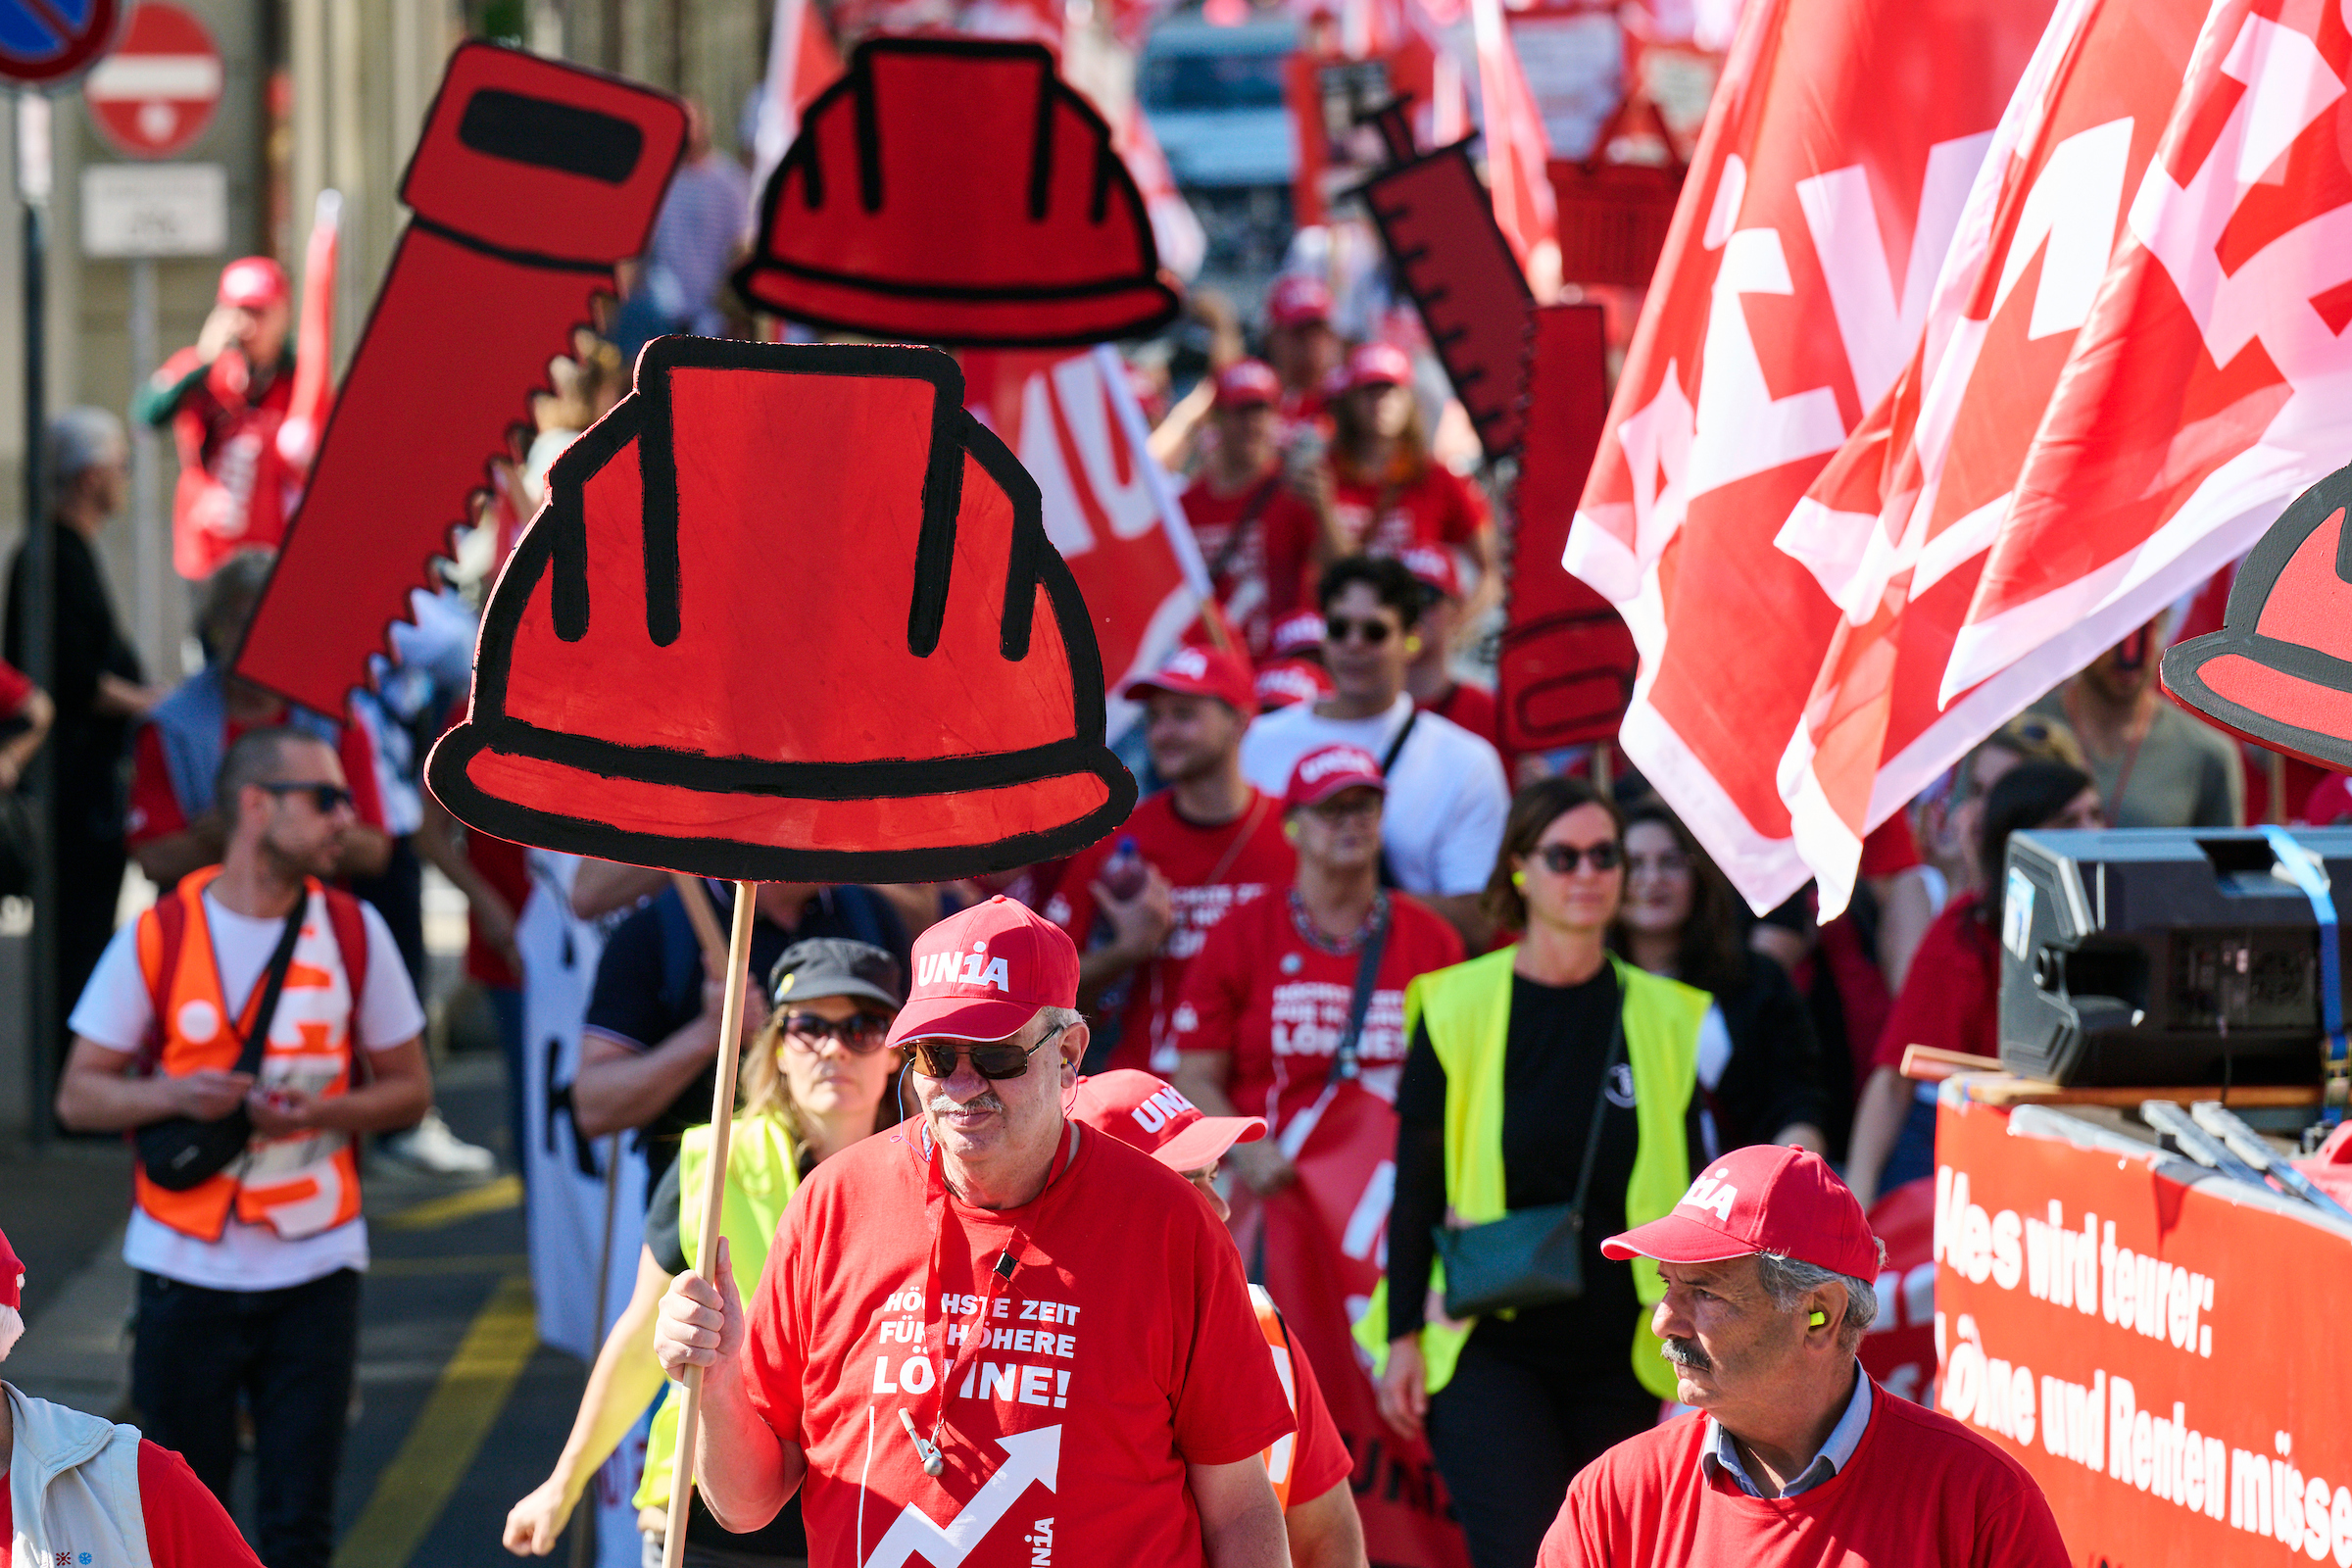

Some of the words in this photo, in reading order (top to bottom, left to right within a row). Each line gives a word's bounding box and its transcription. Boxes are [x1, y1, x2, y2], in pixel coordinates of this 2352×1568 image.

[1019, 1299, 1081, 1326] ZEIT
[2026, 1199, 2098, 1316] wird
[2100, 1220, 2215, 1359] teurer:
[2041, 1369, 2106, 1472] und
[2109, 1375, 2227, 1522] Renten
